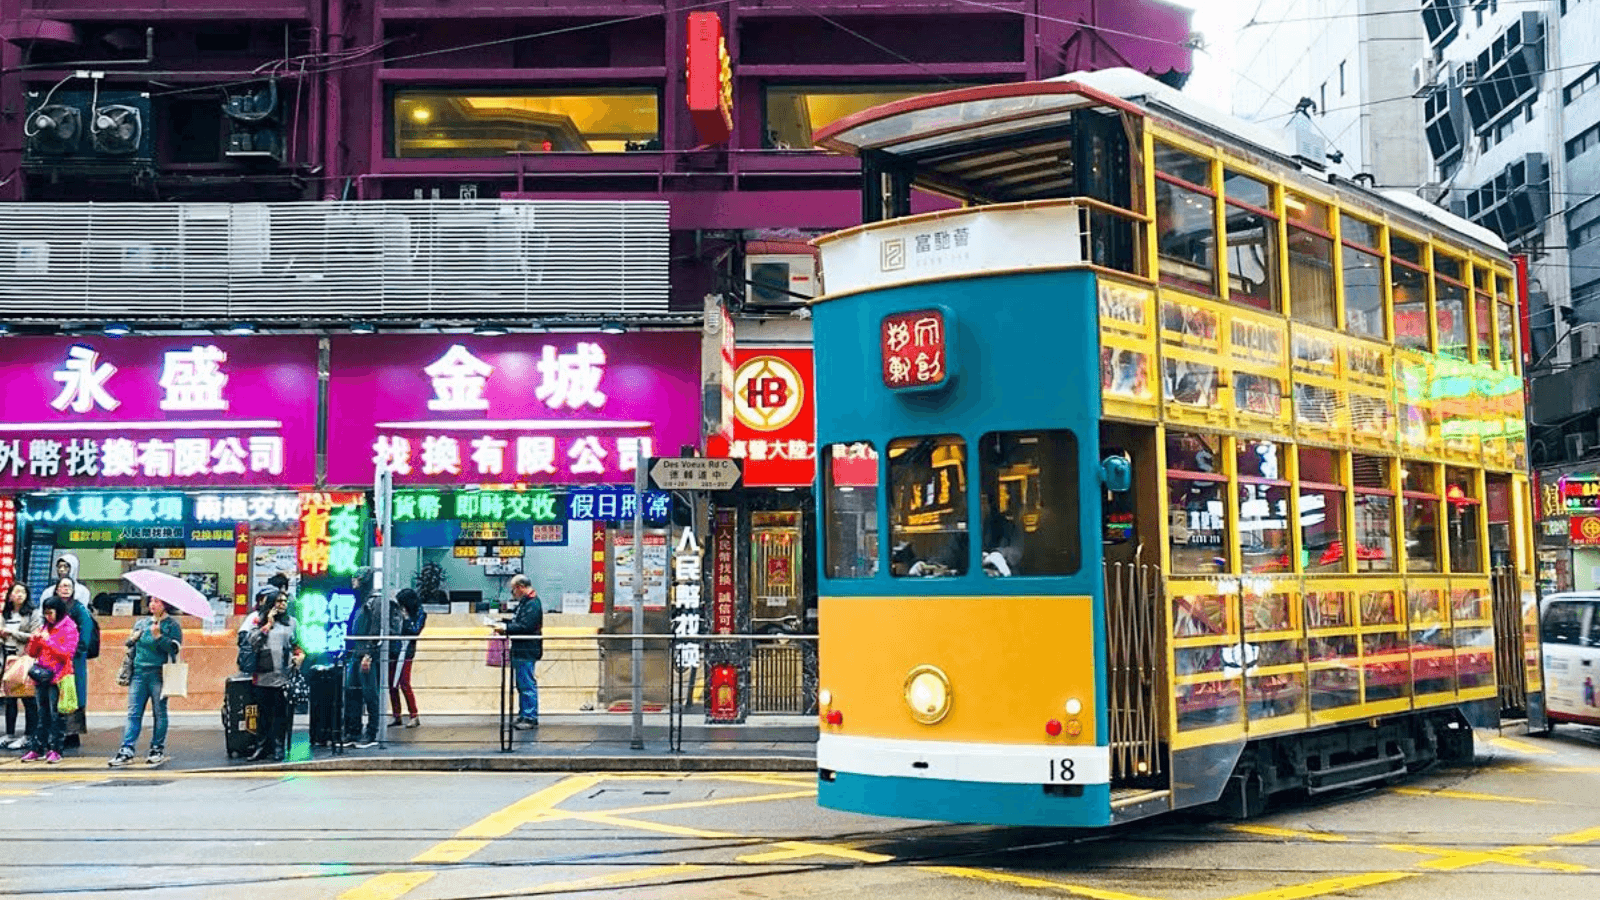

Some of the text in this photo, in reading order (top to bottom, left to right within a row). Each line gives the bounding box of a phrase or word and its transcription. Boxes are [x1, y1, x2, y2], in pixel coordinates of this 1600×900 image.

[51, 345, 229, 412] 永盛
[424, 342, 608, 410] 金城
[747, 377, 788, 408] HB
[0, 437, 283, 476] 外幣找換有限公司
[663, 460, 729, 468] Des Voeux Rd C
[454, 492, 557, 520] 即時交收
[570, 493, 670, 519] 假日照常
[1049, 758, 1076, 782] 18
